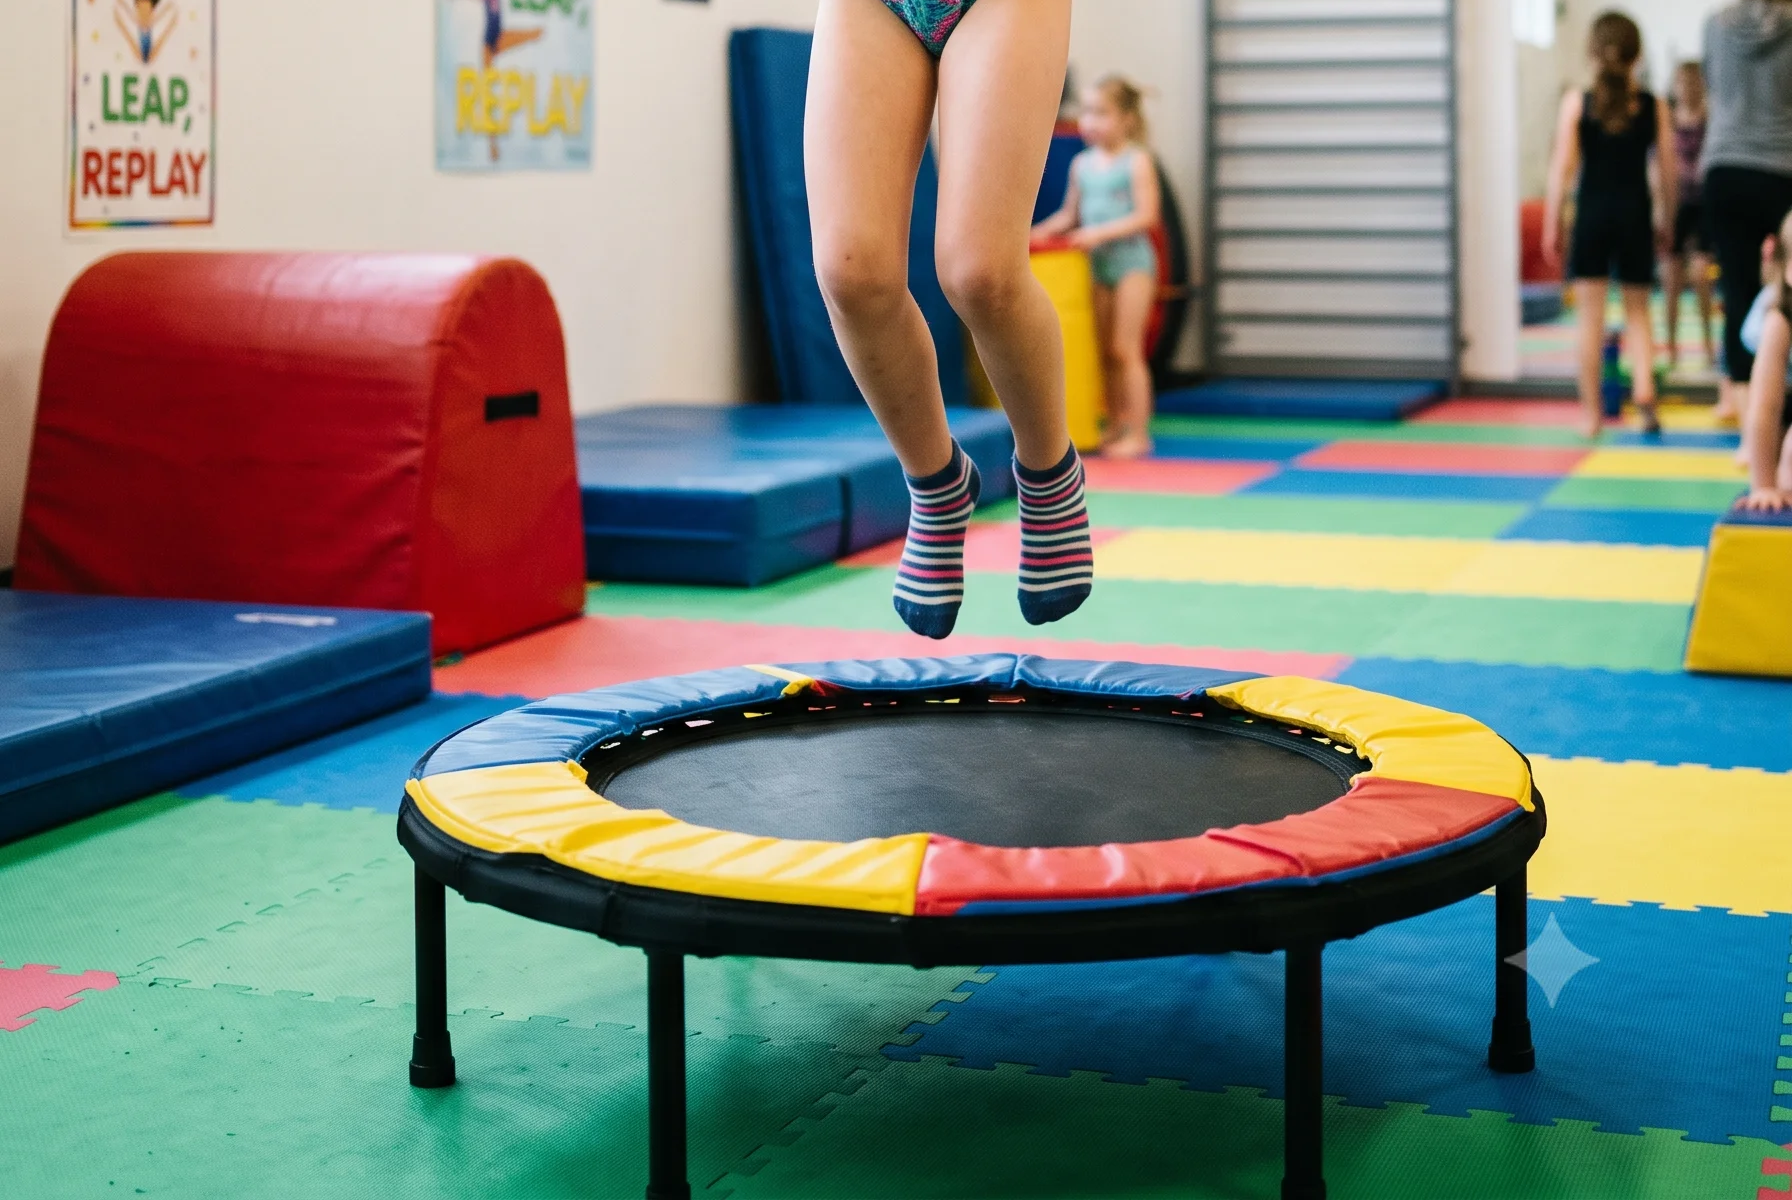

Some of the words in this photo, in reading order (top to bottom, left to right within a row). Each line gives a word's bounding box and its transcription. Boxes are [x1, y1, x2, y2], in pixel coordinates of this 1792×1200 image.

[102, 71, 192, 134] LEAP,
[456, 66, 590, 137] REPLAY
[82, 149, 206, 199] REPLAY
